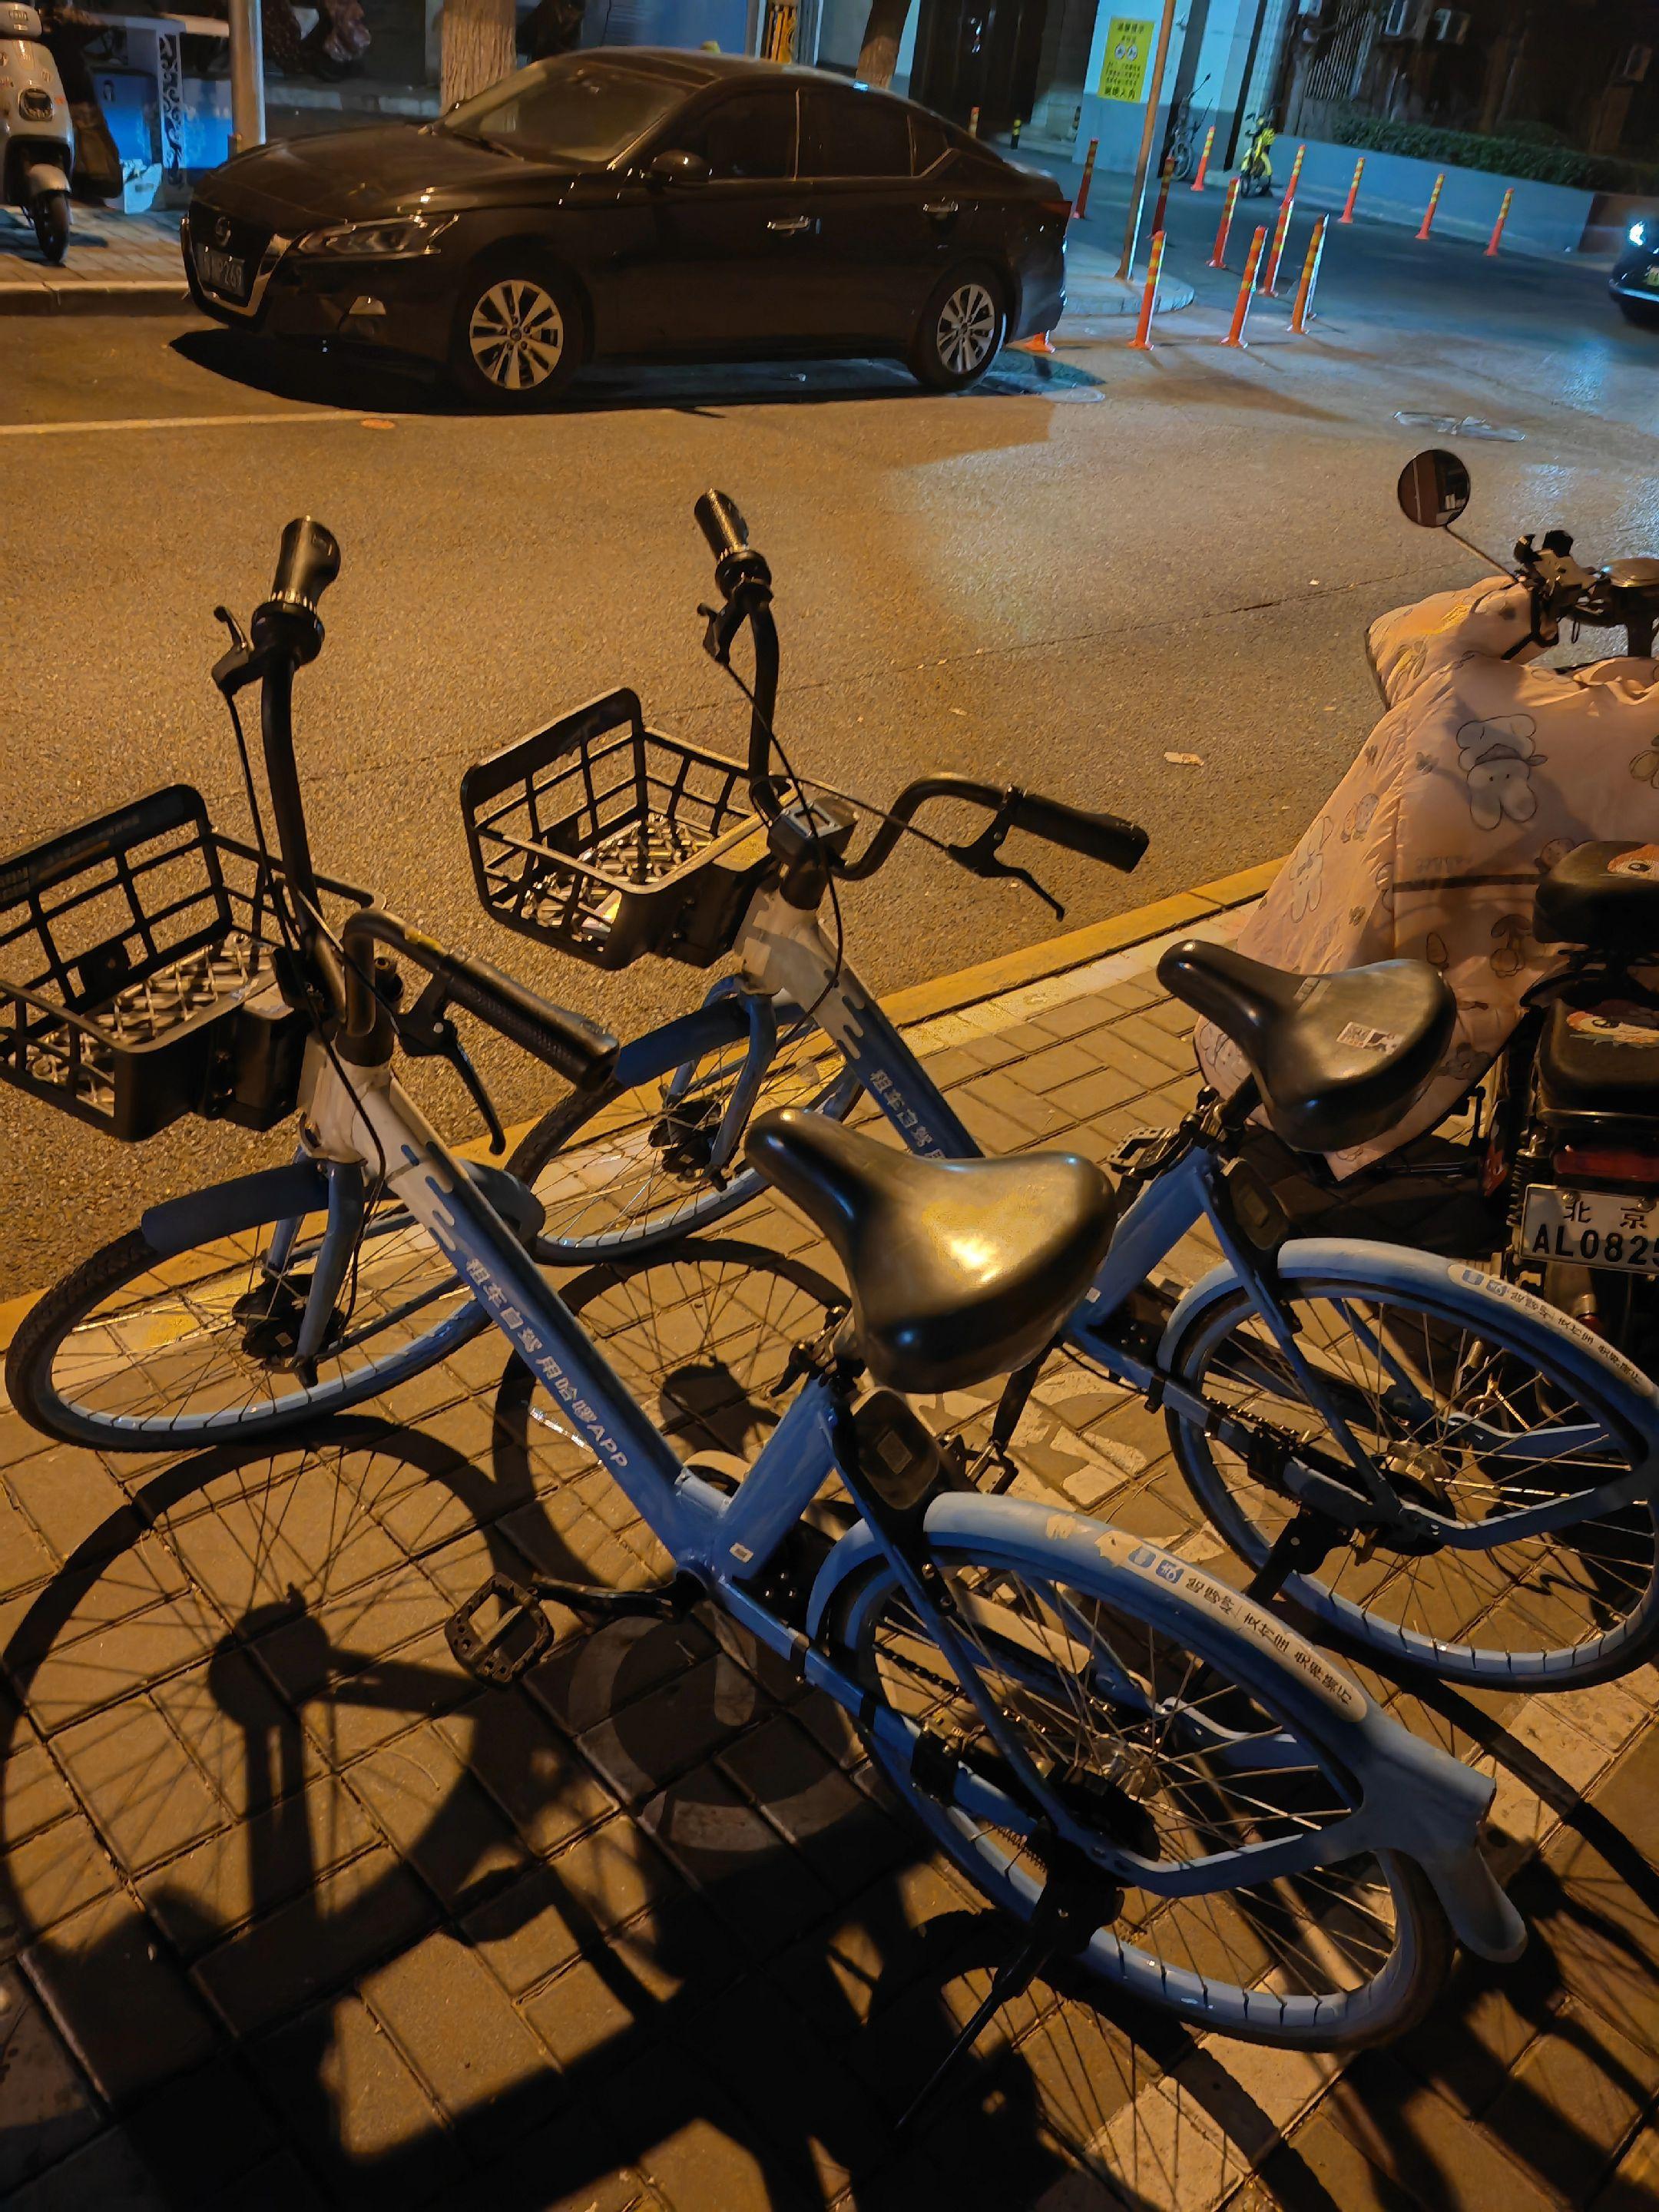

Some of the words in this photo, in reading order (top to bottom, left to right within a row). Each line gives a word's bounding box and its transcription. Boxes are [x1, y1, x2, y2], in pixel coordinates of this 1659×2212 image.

[1563, 1200, 1654, 1229] 北京
[465, 1257, 543, 1353] 租车自驾
[535, 1355, 629, 1468] 用哈啰APP
